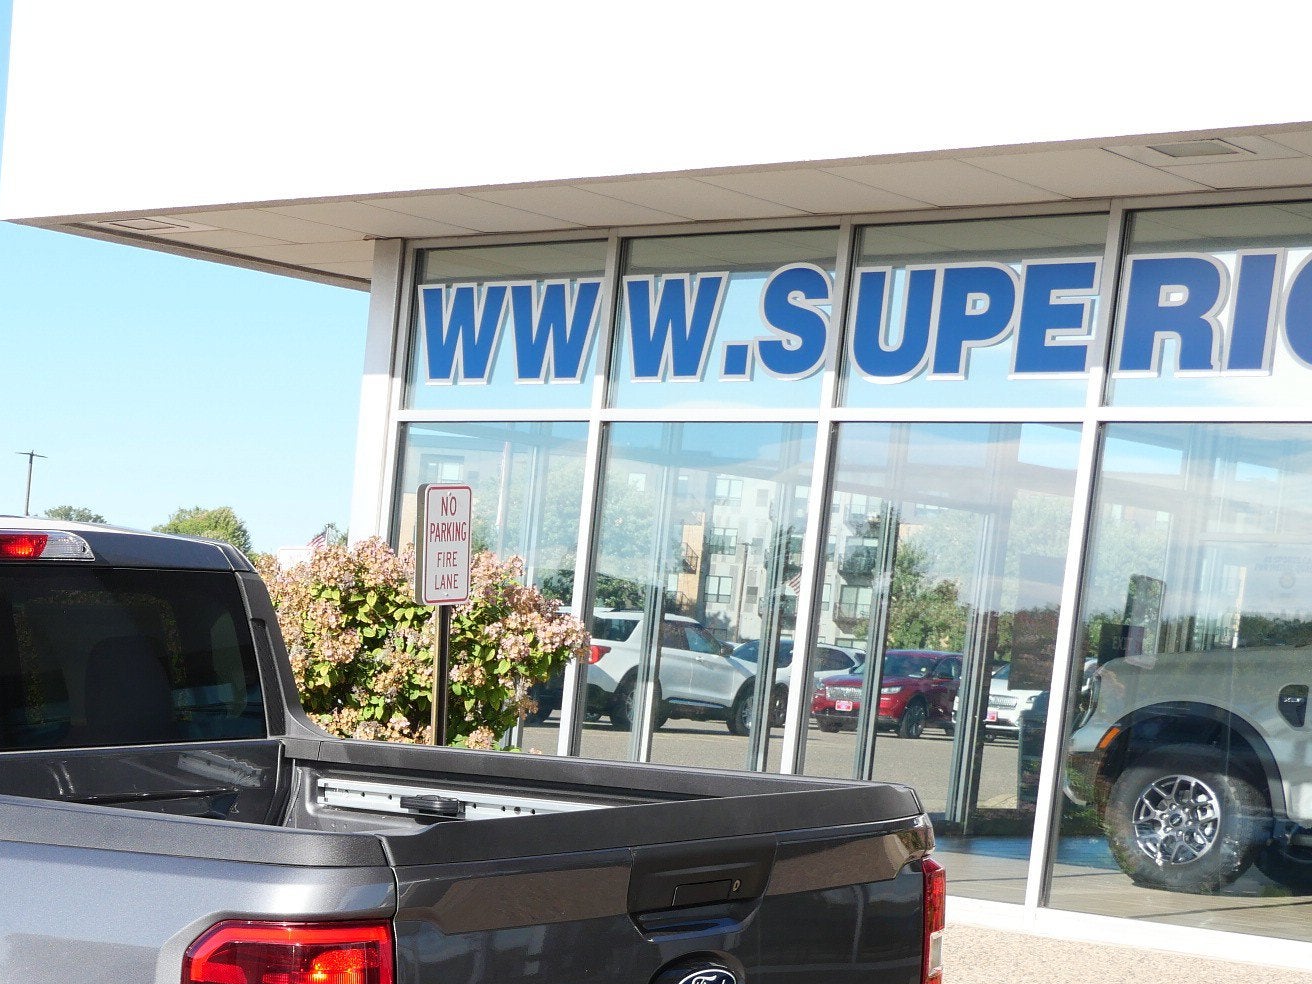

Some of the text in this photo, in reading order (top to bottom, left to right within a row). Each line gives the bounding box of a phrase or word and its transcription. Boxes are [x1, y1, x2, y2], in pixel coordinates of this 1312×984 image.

[417, 247, 1312, 385] WWW.SUPERI
[440, 496, 457, 516] NO
[430, 521, 467, 542] PARKING
[437, 551, 458, 567] FIRE
[434, 573, 459, 590] LANE
